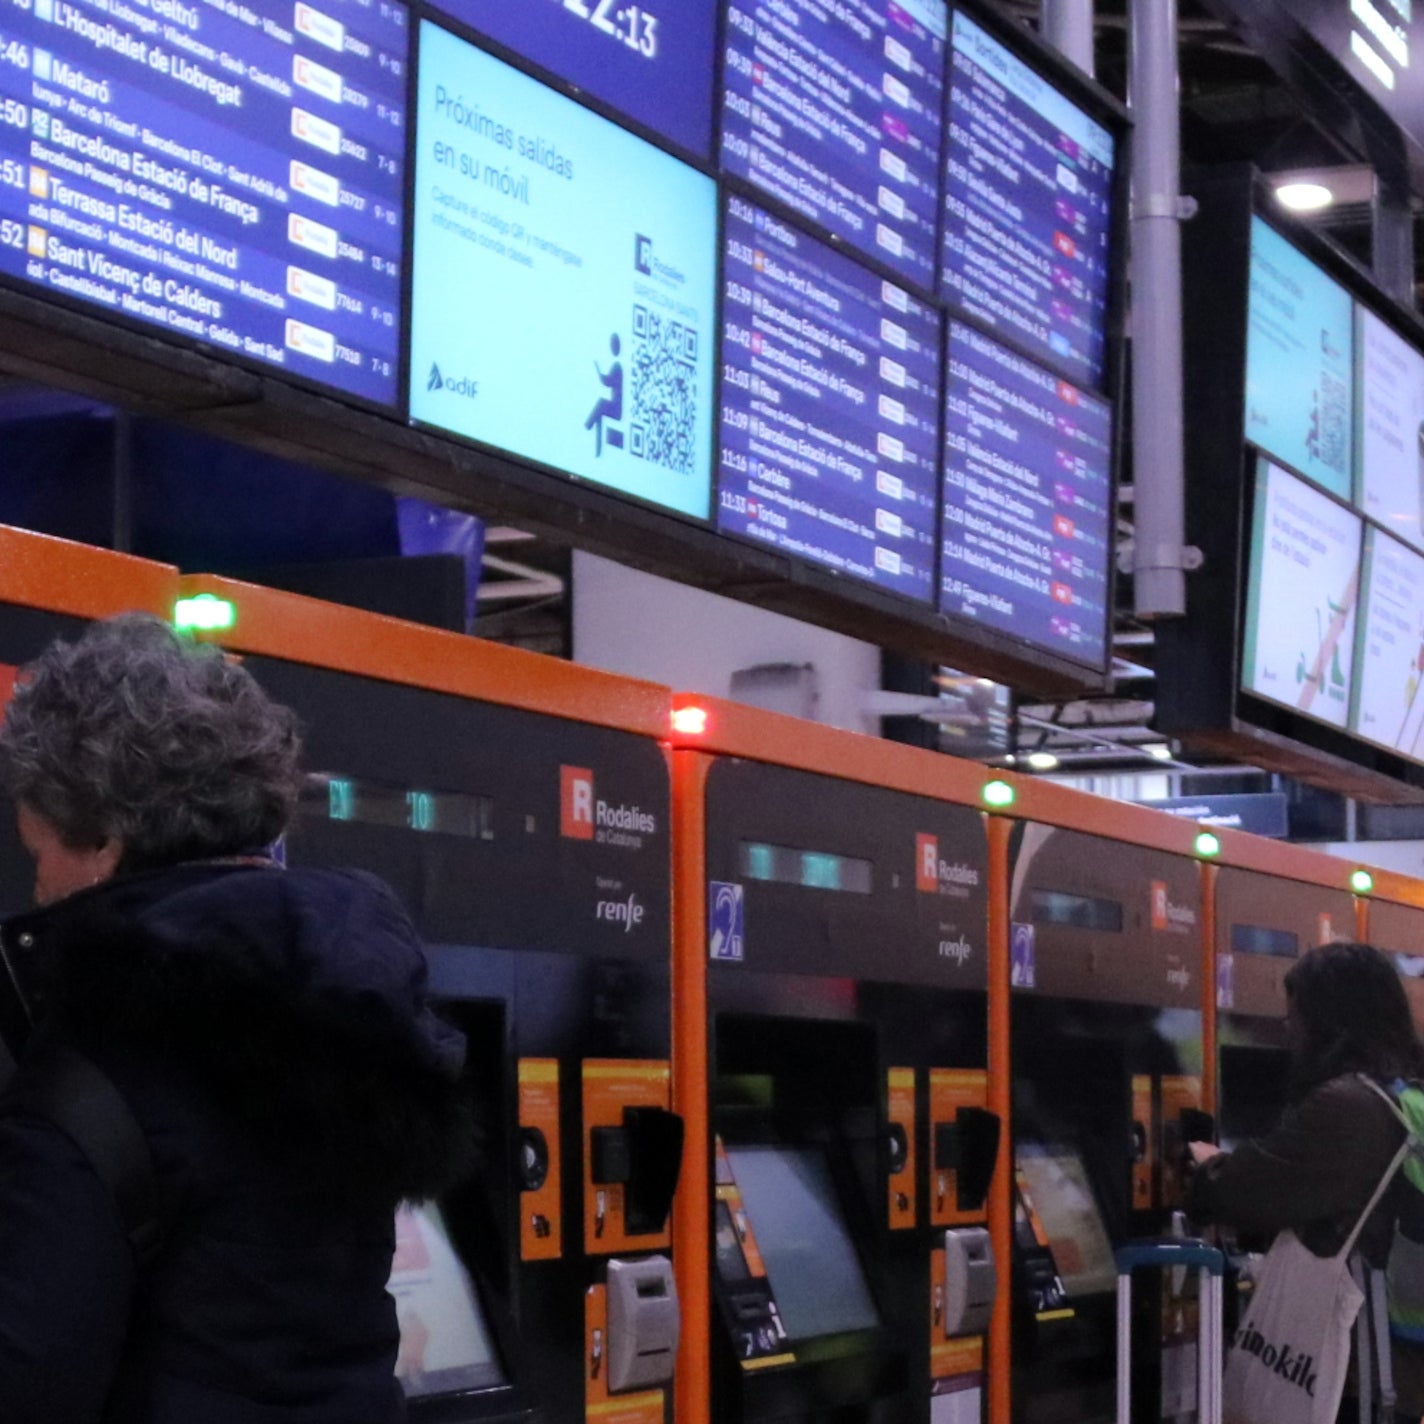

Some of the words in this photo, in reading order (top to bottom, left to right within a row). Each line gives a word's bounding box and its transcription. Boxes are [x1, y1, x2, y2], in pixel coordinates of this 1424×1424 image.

[53, 0, 146, 68] L'Hospitalet
[148, 44, 168, 75] de
[170, 53, 240, 112] Llobregat
[52, 57, 109, 106] Mataró
[434, 81, 513, 153] Próximas
[517, 125, 574, 183] salidas
[30, 138, 82, 177] Barcelona
[50, 117, 130, 173] Barcelona
[132, 149, 186, 195] Estació
[188, 174, 207, 203] de
[209, 184, 258, 229] França
[433, 136, 455, 171] en
[460, 150, 479, 181] su
[483, 154, 530, 208] móvil
[49, 176, 115, 224] Terrassa
[118, 201, 173, 247] Estació
[175, 224, 198, 255] del
[201, 235, 237, 270] Nord
[728, 196, 752, 225] 10:16
[47, 236, 84, 272] Sant
[87, 248, 140, 296] Vicenç
[142, 268, 162, 299] de
[164, 276, 221, 321] Calders
[445, 378, 479, 399] adif
[573, 779, 593, 823] R
[596, 800, 655, 833] Rodalies
[939, 860, 978, 885] Rodalies
[597, 893, 644, 932] renfe
[939, 933, 972, 967] renfe
